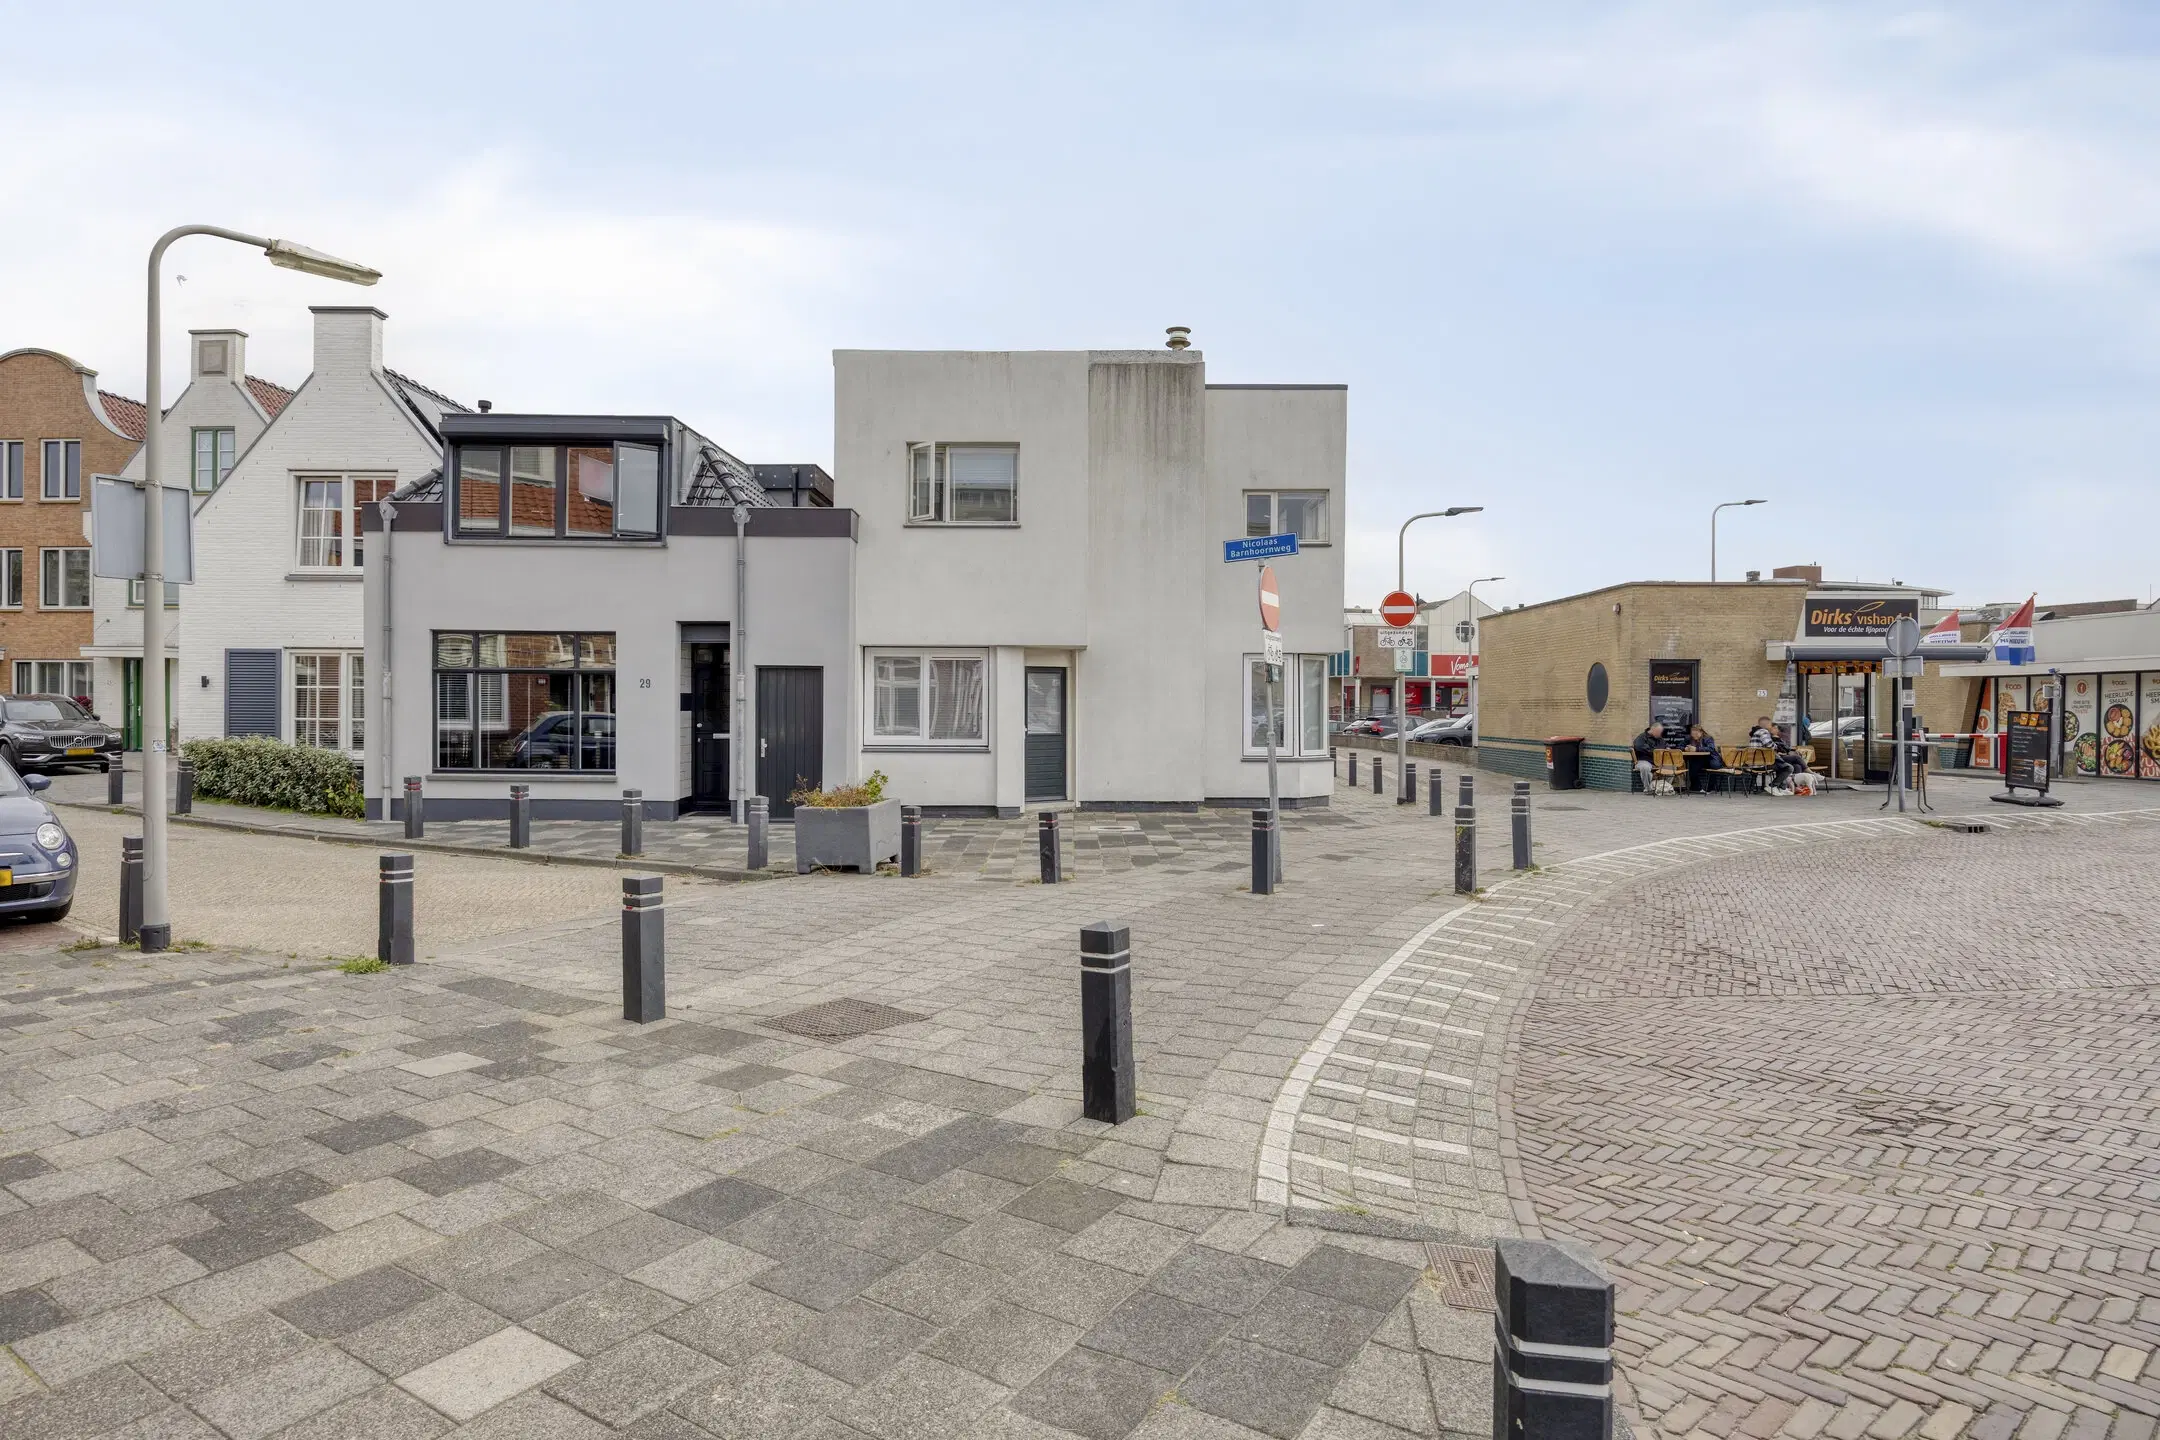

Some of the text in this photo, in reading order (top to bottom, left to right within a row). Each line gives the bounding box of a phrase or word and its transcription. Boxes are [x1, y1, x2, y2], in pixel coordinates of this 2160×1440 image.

[1242, 538, 1278, 549] Nicolaas
[1230, 545, 1291, 558] Barnhoornweg
[1810, 608, 1913, 625] Dirks vishan
[1847, 625, 1864, 633] échte
[639, 678, 651, 689] 29
[2104, 691, 2134, 699] HEERLIJKE
